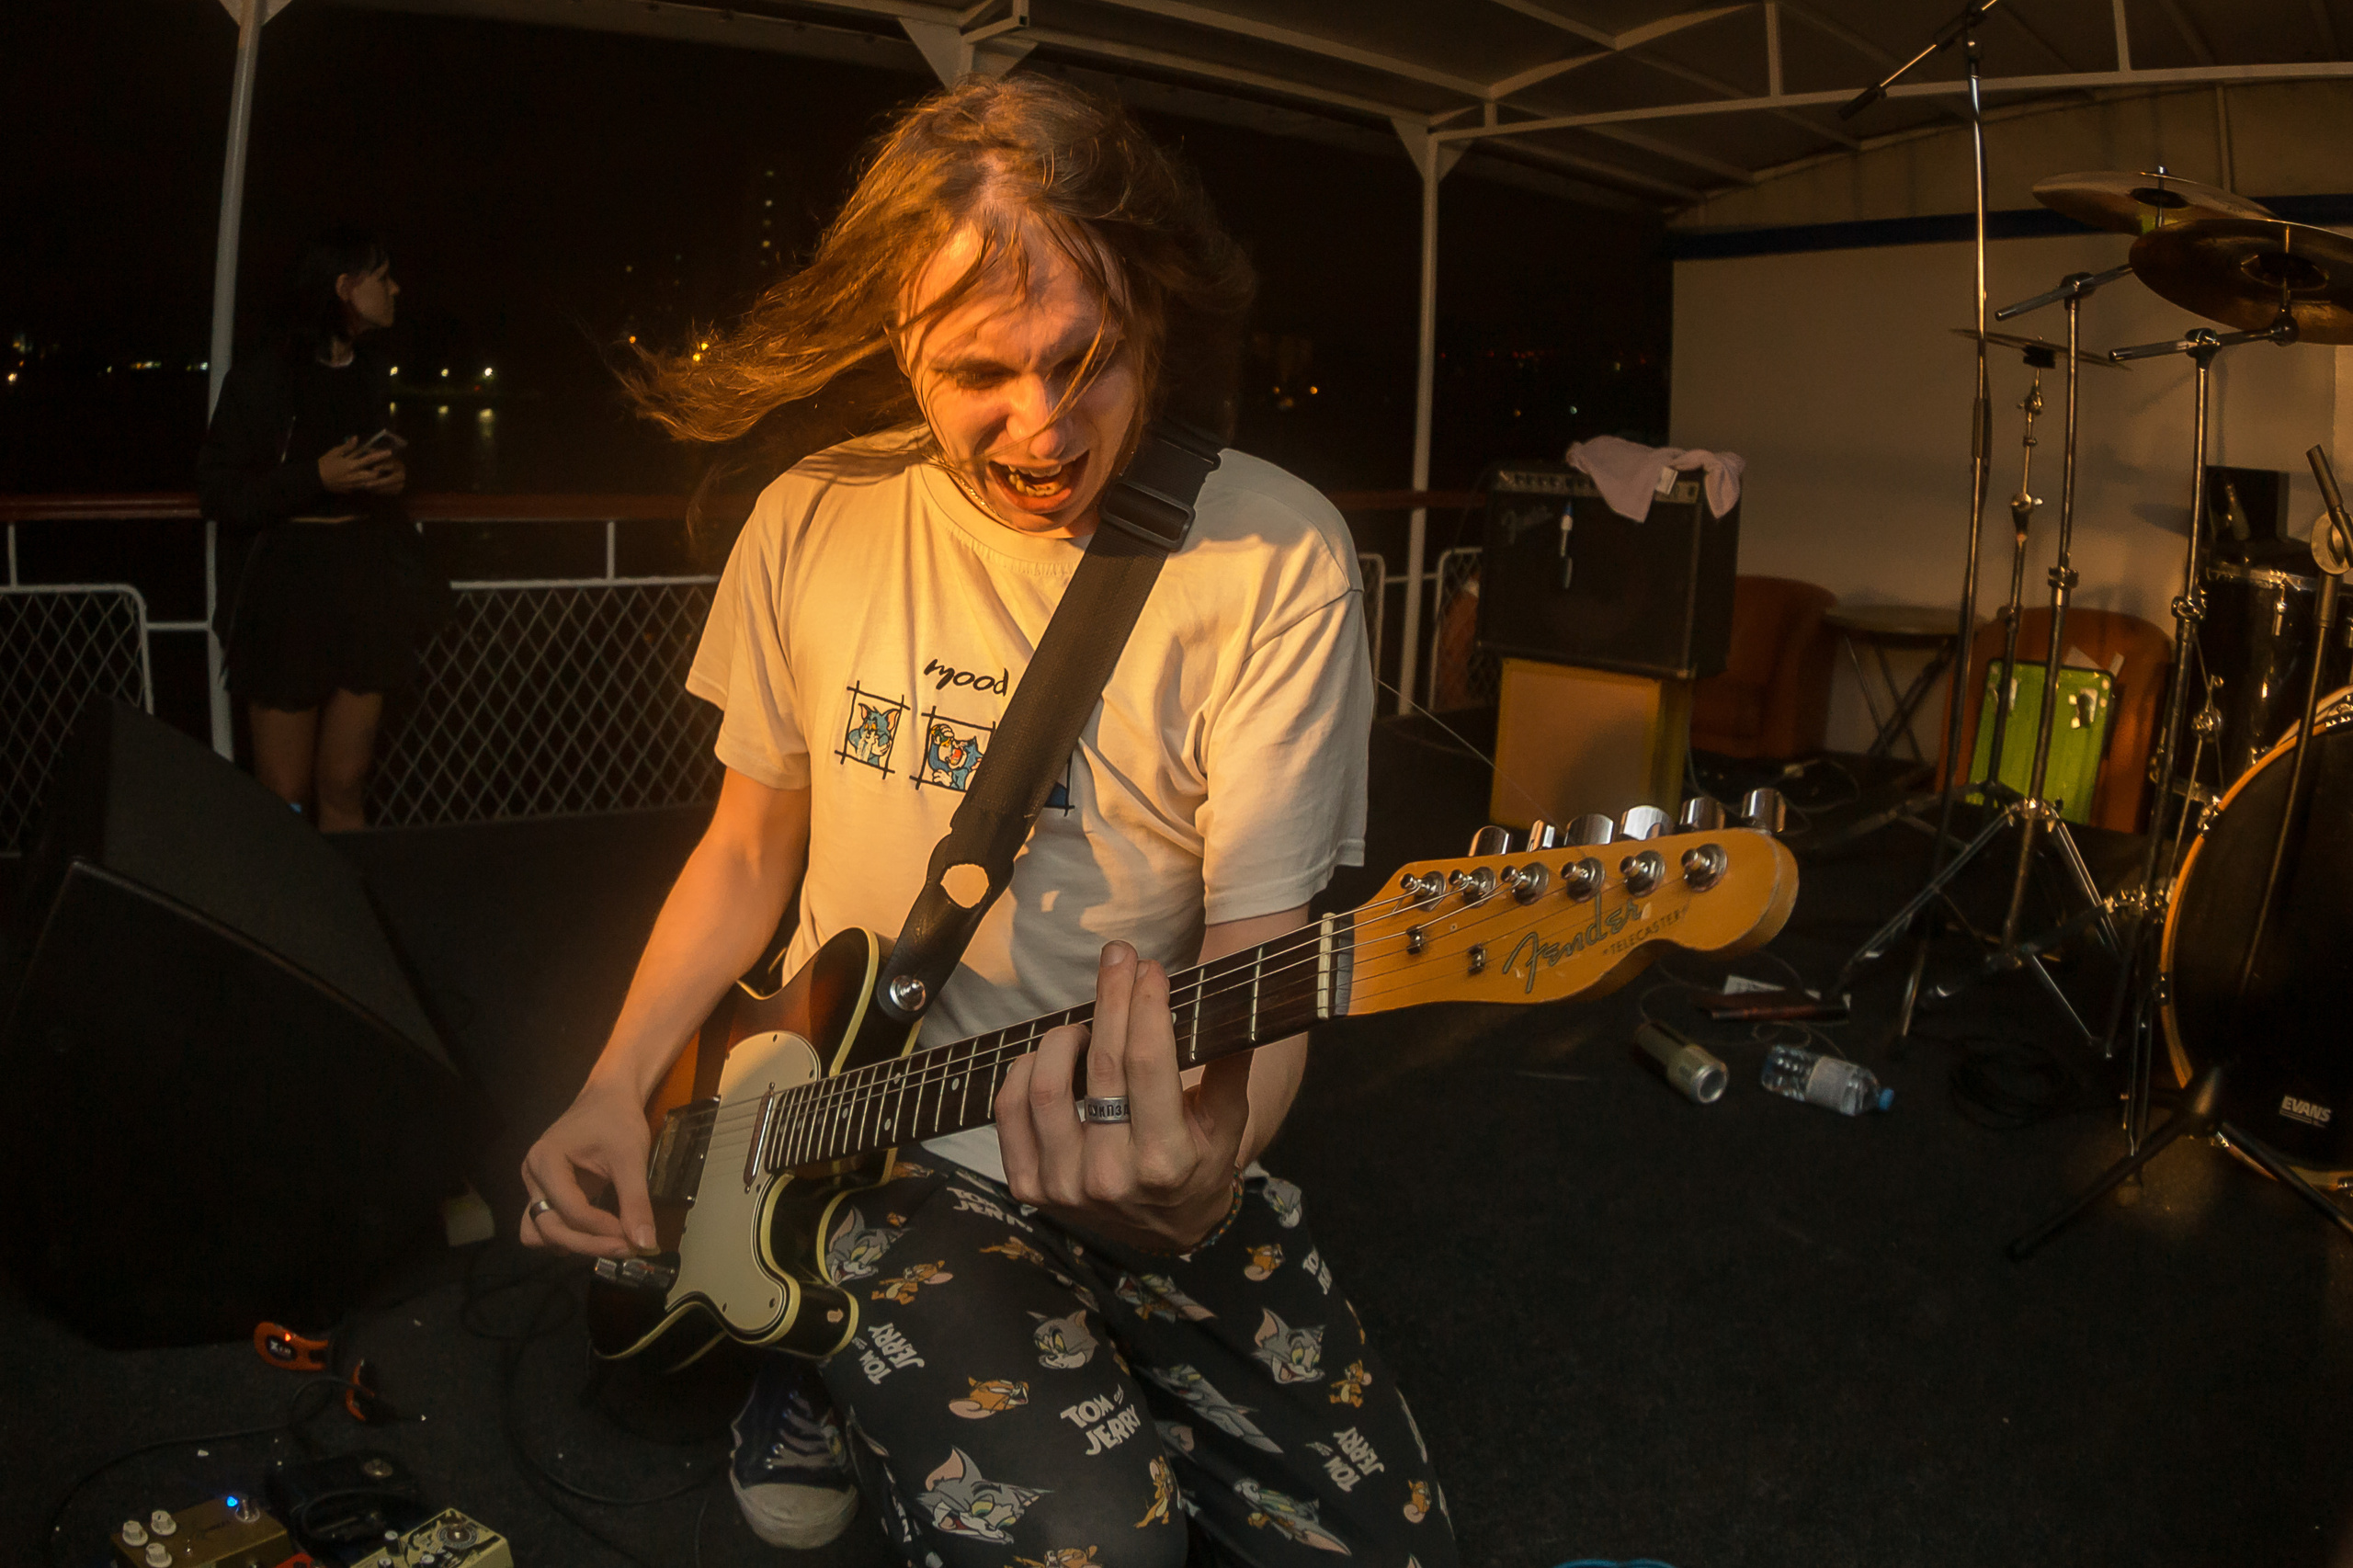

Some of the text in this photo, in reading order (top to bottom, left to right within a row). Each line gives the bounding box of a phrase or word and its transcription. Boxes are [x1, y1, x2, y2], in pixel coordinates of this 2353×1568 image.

[924, 658, 1009, 697] mood
[1502, 891, 1643, 994] Fender
[1609, 908, 1681, 956] TELECASTER
[2281, 1096, 2332, 1122] EVANS
[858, 1349, 892, 1385] TOM
[868, 1322, 926, 1369] JERRY
[1060, 1393, 1115, 1429] TOM
[1085, 1403, 1142, 1456] JERRY
[1333, 1426, 1385, 1476] JERRY
[1323, 1455, 1361, 1493] TOM
